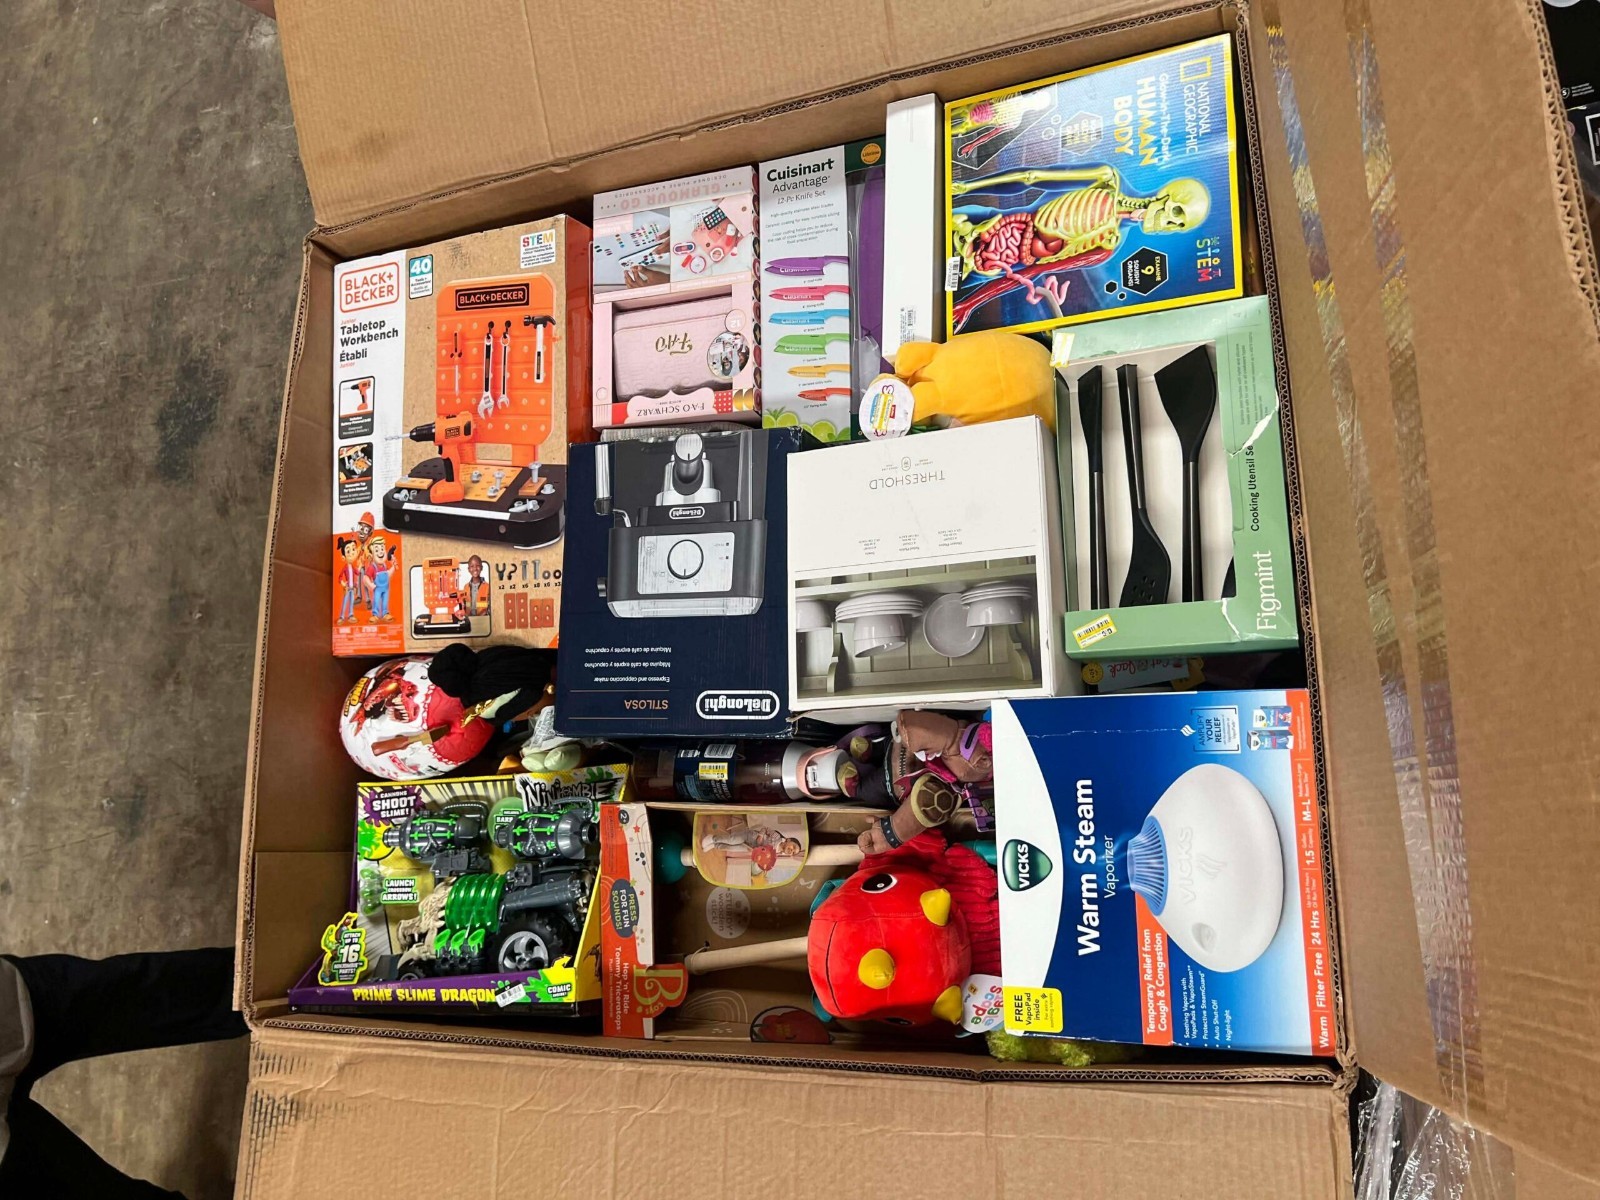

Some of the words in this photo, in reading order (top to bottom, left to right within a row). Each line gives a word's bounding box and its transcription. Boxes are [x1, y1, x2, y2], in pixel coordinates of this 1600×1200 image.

[1184, 84, 1198, 154] GEOGRAPHIC
[1198, 81, 1210, 137] NATIONAL
[1114, 95, 1134, 155] BODY
[1136, 76, 1158, 166] HUMAN
[767, 158, 834, 182] Cuisinart
[648, 183, 720, 205] GLAMOUR
[777, 196, 794, 204] 12-Pc
[795, 192, 813, 201] Knife
[621, 200, 640, 210] GO
[522, 233, 553, 247] STEM
[411, 258, 431, 274] 40
[1141, 265, 1154, 275] 9
[1197, 238, 1212, 282] STEM
[345, 272, 393, 291] BLACK+
[345, 284, 394, 305] DECKER
[460, 291, 524, 304] BLACK+DECKER
[340, 320, 386, 336] Tabletop
[730, 318, 742, 328] 12
[340, 328, 398, 347] Workbench
[340, 348, 367, 362] Établi
[637, 405, 680, 417] SCHWARZ
[1246, 446, 1254, 456] Se
[869, 470, 945, 490] THRESHOLD
[1246, 458, 1257, 490] Utensil
[1249, 488, 1260, 532] Cooking
[1253, 550, 1281, 630] Figmint
[1110, 661, 1136, 678] Jack
[624, 699, 668, 710] STILOSA
[1205, 719, 1213, 742] YOUR
[372, 796, 416, 811] SHOOT
[380, 808, 410, 818] SLIME!
[619, 811, 627, 822] 2+
[1073, 779, 1096, 865] Steam
[1018, 843, 1030, 889] VICKS
[1104, 835, 1119, 898] Vaporizer
[1306, 851, 1315, 865] 1.5
[385, 880, 414, 888] LAUNCH
[382, 892, 417, 901] ARROWS!
[620, 889, 628, 906] FOR
[612, 890, 622, 931] SOUNDS!
[628, 893, 637, 921] PRESS
[1077, 874, 1100, 956] Warm
[622, 909, 630, 928] FUN
[1310, 910, 1320, 930] Hrs
[1142, 929, 1150, 953] from
[1311, 932, 1321, 945] 24
[339, 944, 359, 962] 16
[1154, 933, 1166, 987] Congestion
[1143, 955, 1152, 980] Relief
[1314, 952, 1324, 975] Free
[547, 983, 571, 993] COMIC
[633, 965, 684, 1005] B
[1157, 989, 1165, 998] &
[1315, 977, 1326, 1008] Filter
[352, 988, 394, 1002] PRIME
[397, 988, 436, 1002] SLIME
[441, 988, 495, 1006] DRAGON
[1014, 995, 1023, 1022] FREE
[1147, 983, 1155, 1034] Temporary
[1158, 1000, 1168, 1031] Cough
[1319, 1016, 1329, 1049] Warm
